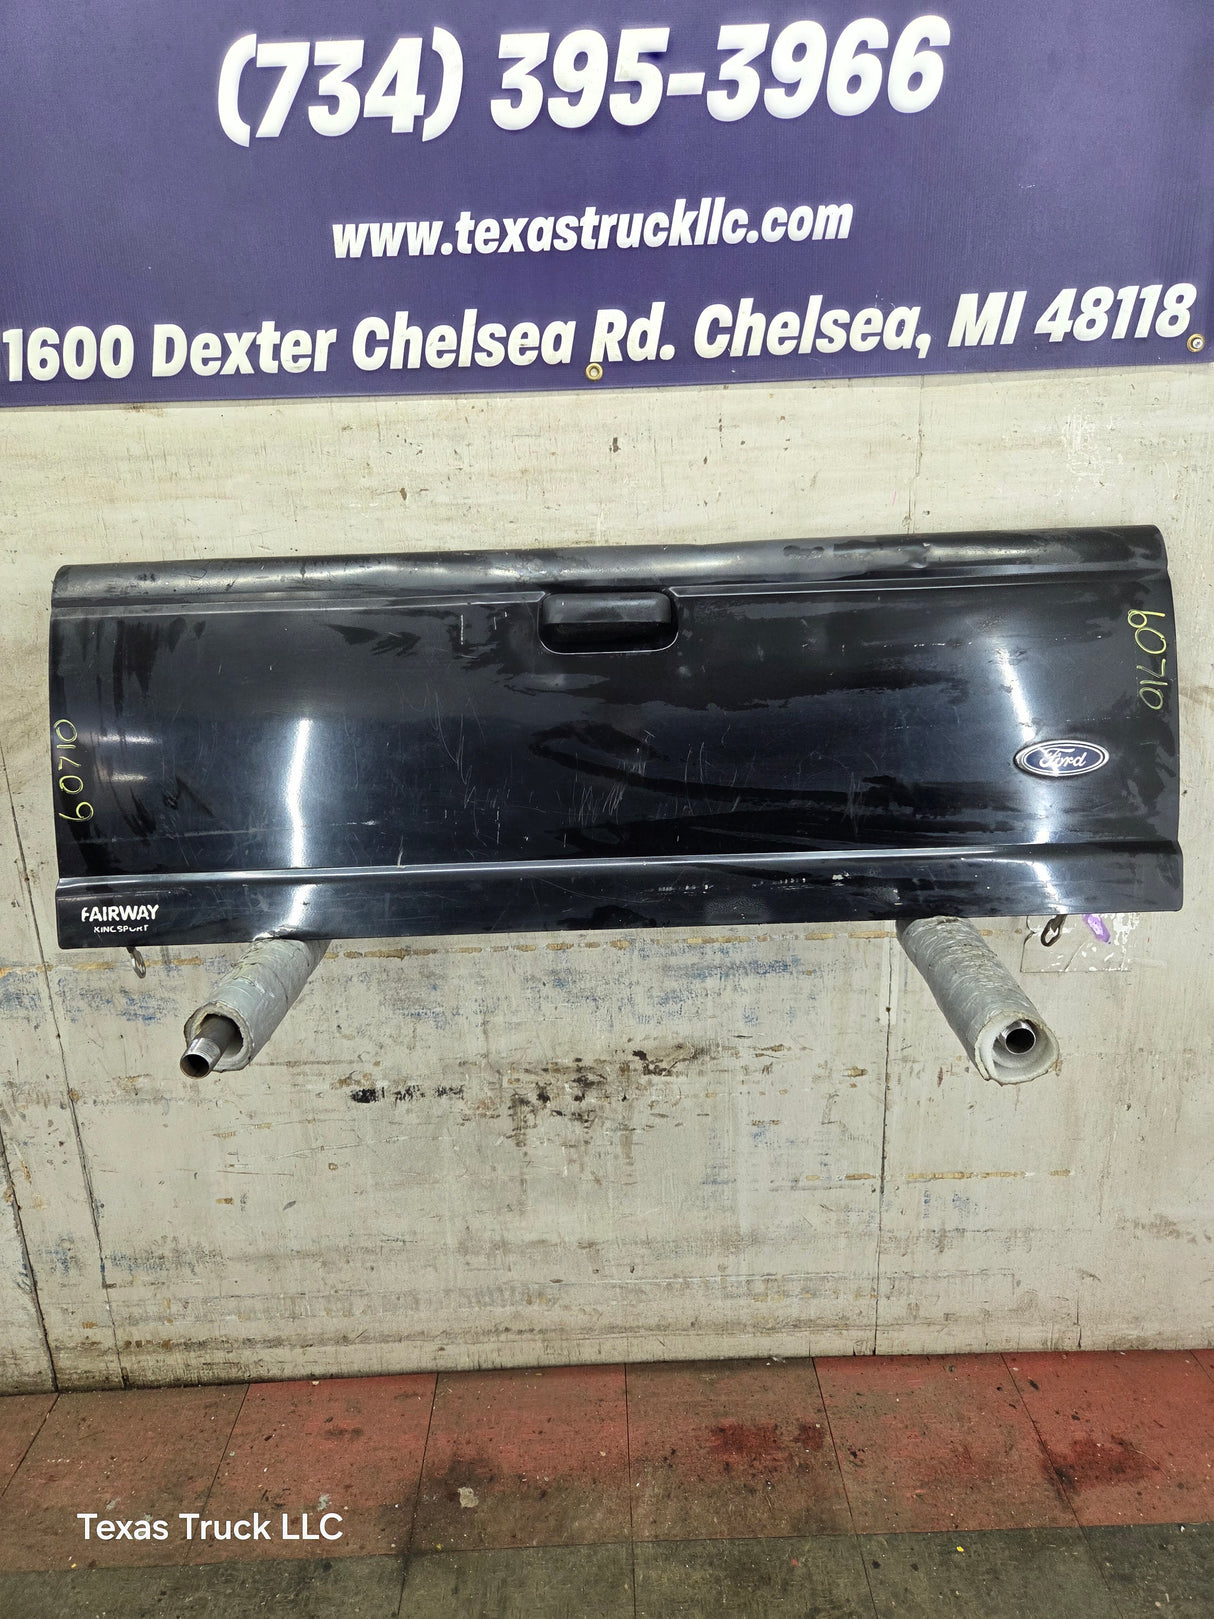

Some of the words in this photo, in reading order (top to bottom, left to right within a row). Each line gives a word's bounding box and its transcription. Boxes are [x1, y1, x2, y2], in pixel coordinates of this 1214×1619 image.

[217, 25, 464, 147] (734)
[490, 15, 951, 132] 395-3966
[332, 195, 854, 259] www.texastruckllc.com
[3, 323, 135, 382] 1600
[151, 314, 338, 378] Dexter
[352, 308, 577, 371] Chelsea
[590, 302, 676, 363] Rd.
[694, 303, 932, 360] Chelsea,
[947, 290, 1027, 348] MI
[1034, 282, 1198, 344] 48118
[1127, 608, 1168, 710] 60710
[53, 719, 94, 822] 60710
[1038, 747, 1087, 769] Ford
[81, 904, 159, 922] FAIRWAY
